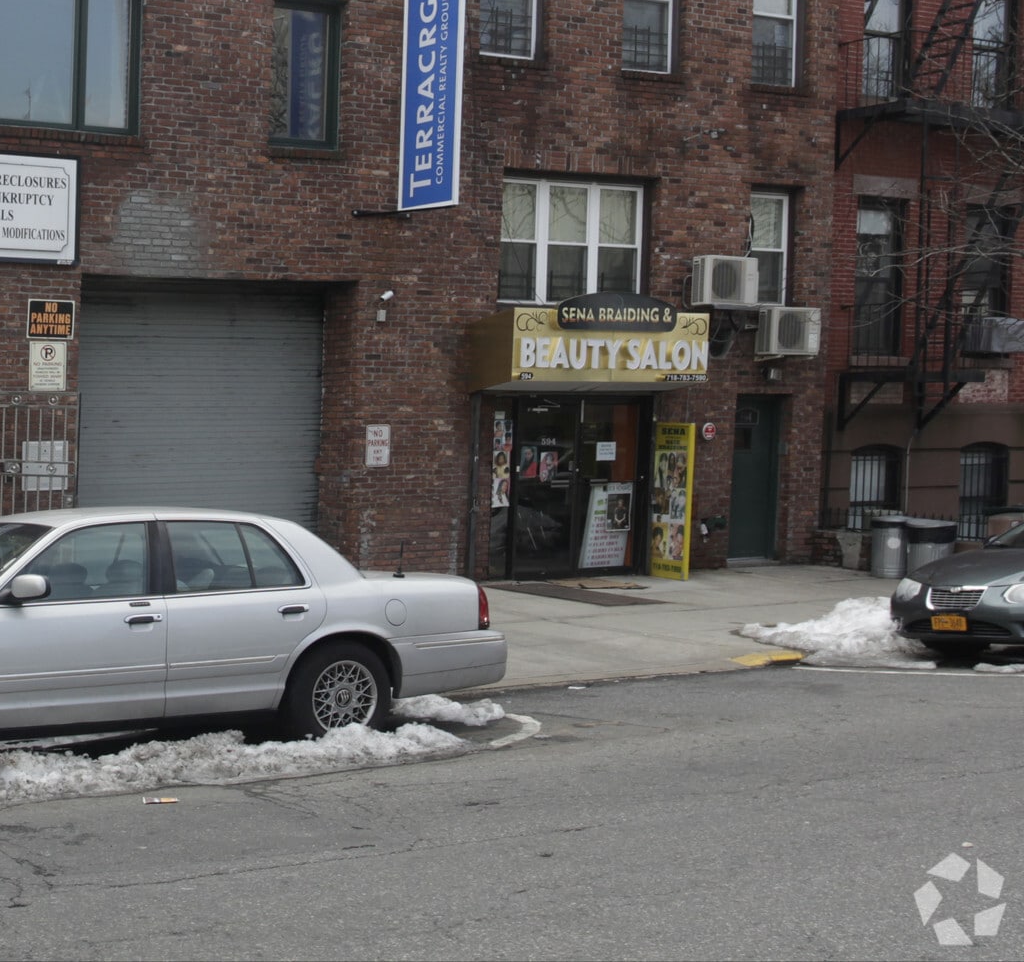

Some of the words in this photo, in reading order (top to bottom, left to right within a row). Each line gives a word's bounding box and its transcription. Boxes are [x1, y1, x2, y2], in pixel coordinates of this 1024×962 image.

[438, 46, 448, 91] REALTY
[435, 94, 447, 185] COMMERCIAL
[2, 227, 65, 241] MODIFICATIONS
[45, 302, 58, 312] NO
[31, 313, 71, 324] PARKING
[561, 307, 595, 323] SENA
[599, 307, 659, 323] BRAIDING
[662, 307, 672, 323] &
[30, 324, 71, 335] ANYTIME
[520, 336, 625, 370] BEAUTY
[626, 338, 709, 371] SALON
[373, 430, 383, 438] NO
